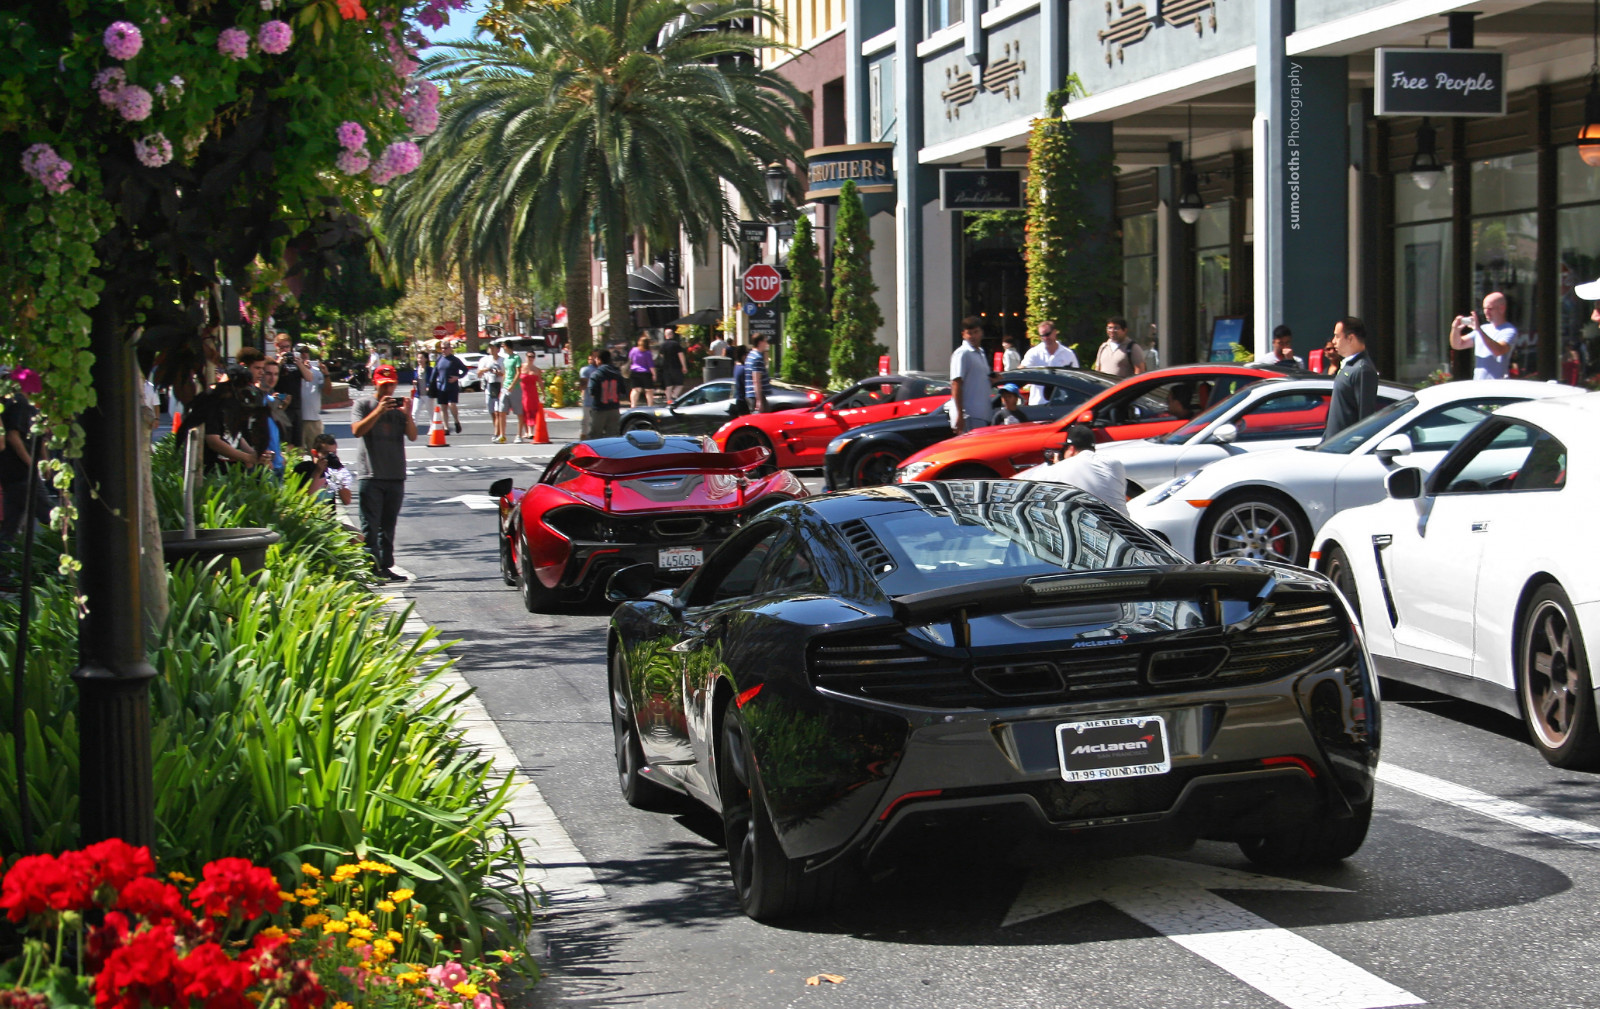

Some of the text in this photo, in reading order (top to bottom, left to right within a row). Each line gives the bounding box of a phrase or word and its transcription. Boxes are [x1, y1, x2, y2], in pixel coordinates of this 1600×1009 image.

[1391, 71, 1495, 96] Free People
[745, 276, 778, 291] STOP
[746, 305, 754, 314] P
[547, 334, 559, 347] V
[1071, 639, 1123, 649] McLaren
[1085, 718, 1134, 728] MEMBER
[1070, 740, 1148, 755] McLaren
[1071, 764, 1161, 781] 11-99 FOUNDATION
